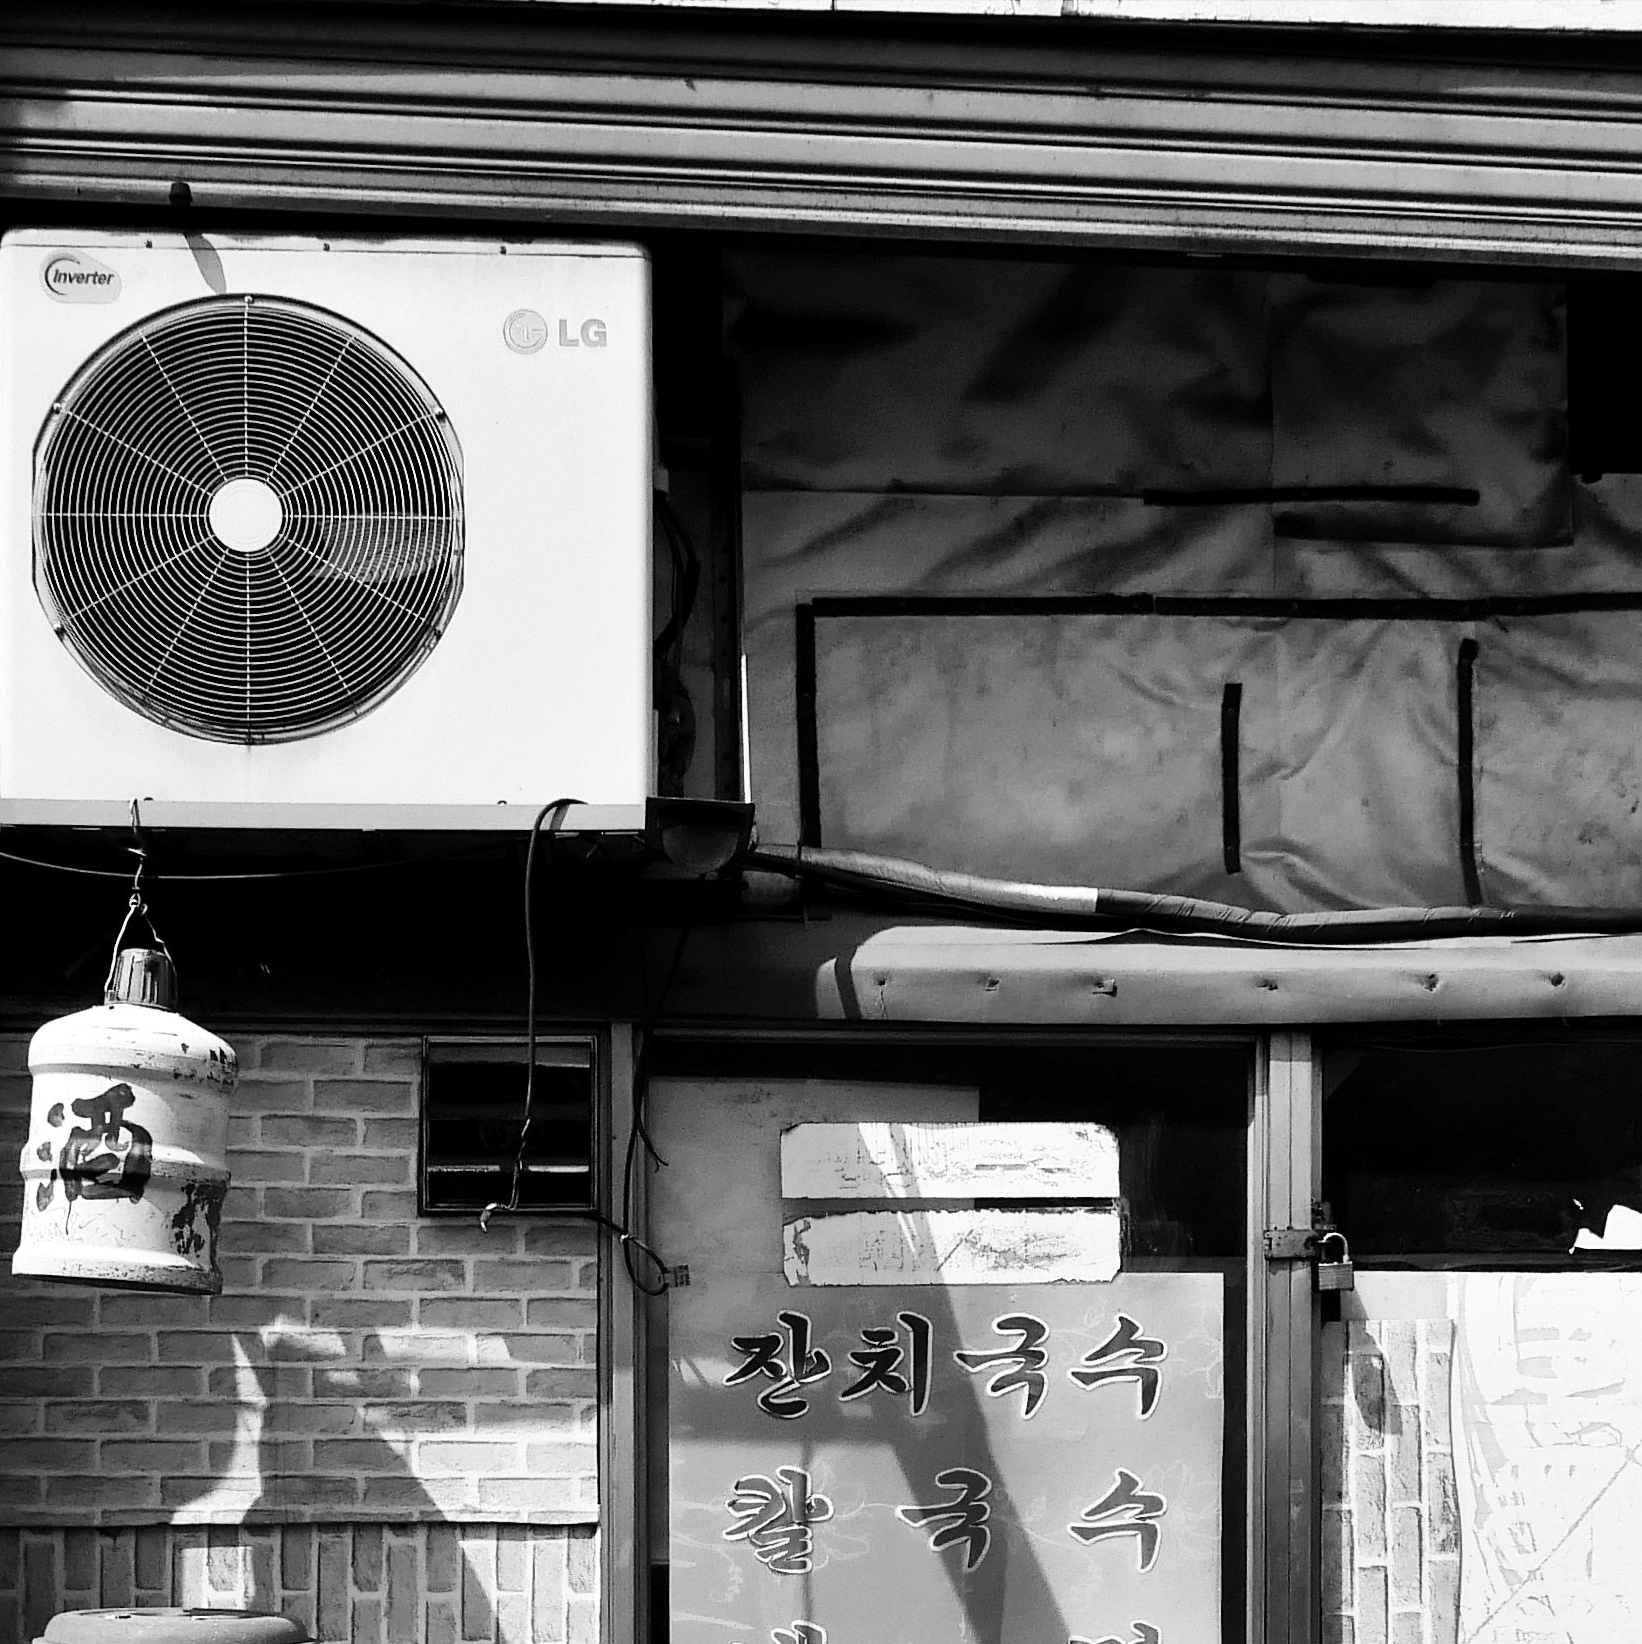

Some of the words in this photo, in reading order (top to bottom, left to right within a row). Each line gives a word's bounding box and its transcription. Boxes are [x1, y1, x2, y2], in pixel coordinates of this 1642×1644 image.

[53, 268, 115, 286] Inverter
[558, 318, 607, 348] LG
[724, 1311, 1169, 1419] 잔치국수
